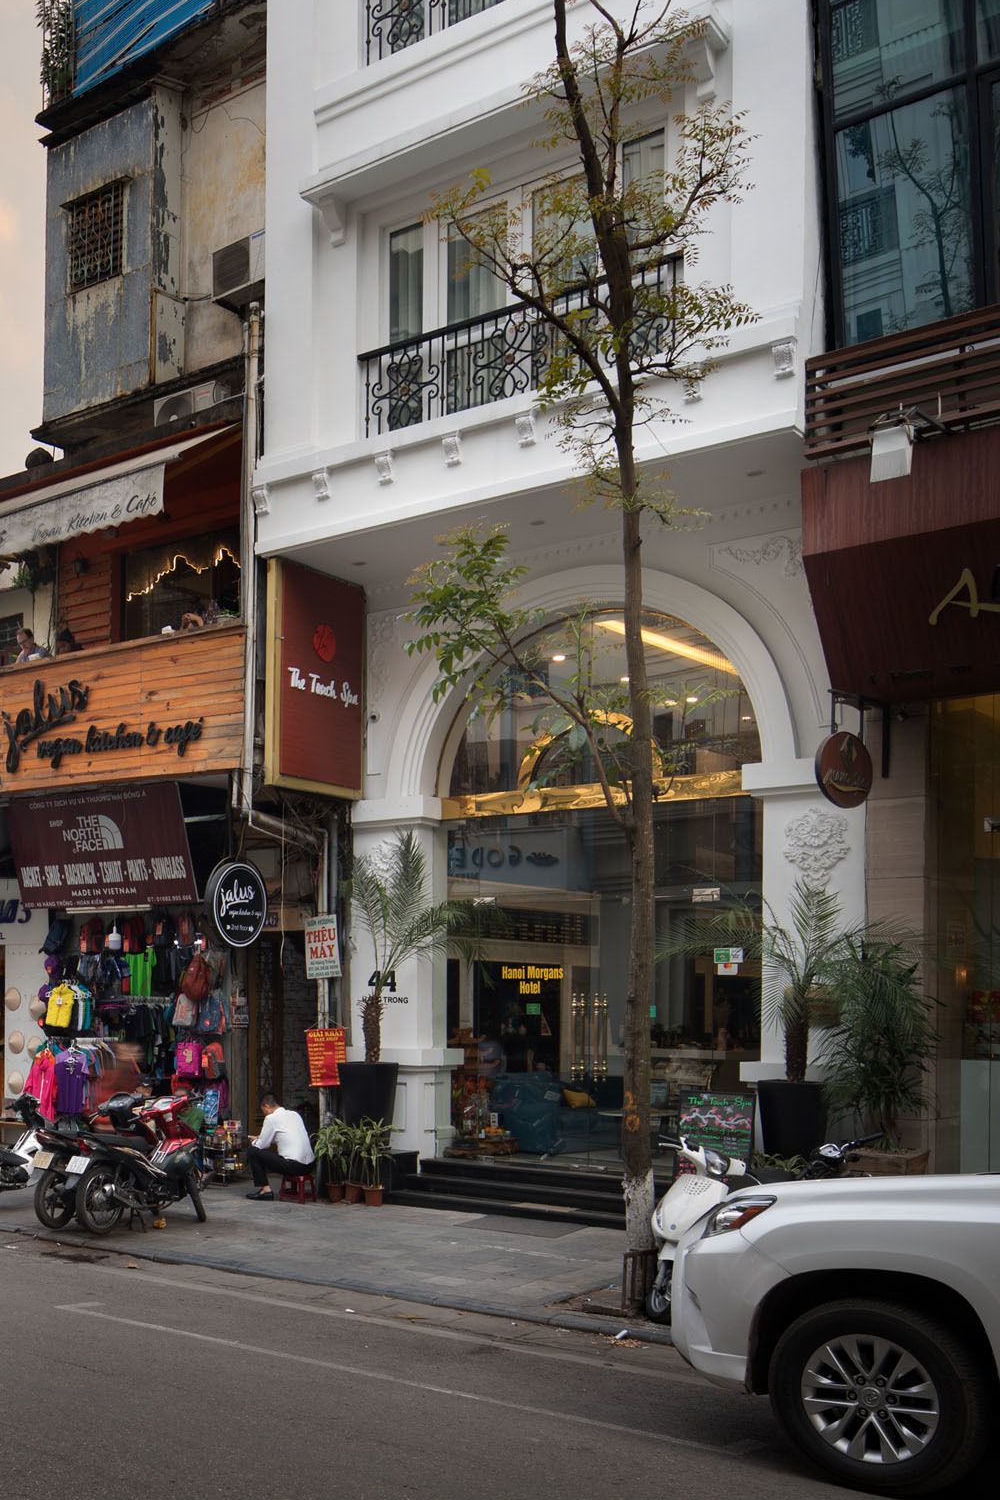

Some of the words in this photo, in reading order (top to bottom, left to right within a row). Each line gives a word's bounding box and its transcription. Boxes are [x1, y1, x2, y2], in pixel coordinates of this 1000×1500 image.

[66, 510, 107, 532] Kitchen
[110, 504, 122, 518] &
[126, 491, 156, 514] Café
[287, 667, 306, 690] The
[308, 673, 337, 699] Touch
[340, 681, 359, 708] Spa
[1, 679, 90, 774] jalus
[37, 737, 83, 769] vegan
[85, 722, 145, 754] kitchen
[164, 717, 204, 757] café
[76, 815, 99, 828] THE
[62, 826, 103, 842] NORTH
[75, 839, 104, 852] FACE
[126, 858, 149, 882] PANTS
[151, 856, 187, 880] SUNGLASS
[71, 889, 92, 897] MADE
[103, 887, 137, 895] VIETNAM
[220, 879, 255, 918] jalus
[306, 925, 336, 943] THÊU
[309, 943, 335, 959] MÁY
[502, 965, 525, 980] Hanoi
[527, 965, 564, 980] Morgans
[368, 970, 396, 992] 44
[519, 980, 541, 994] Hotel
[383, 996, 409, 1004] TRONG
[687, 1096, 704, 1106] The
[735, 1096, 752, 1109] Spa
